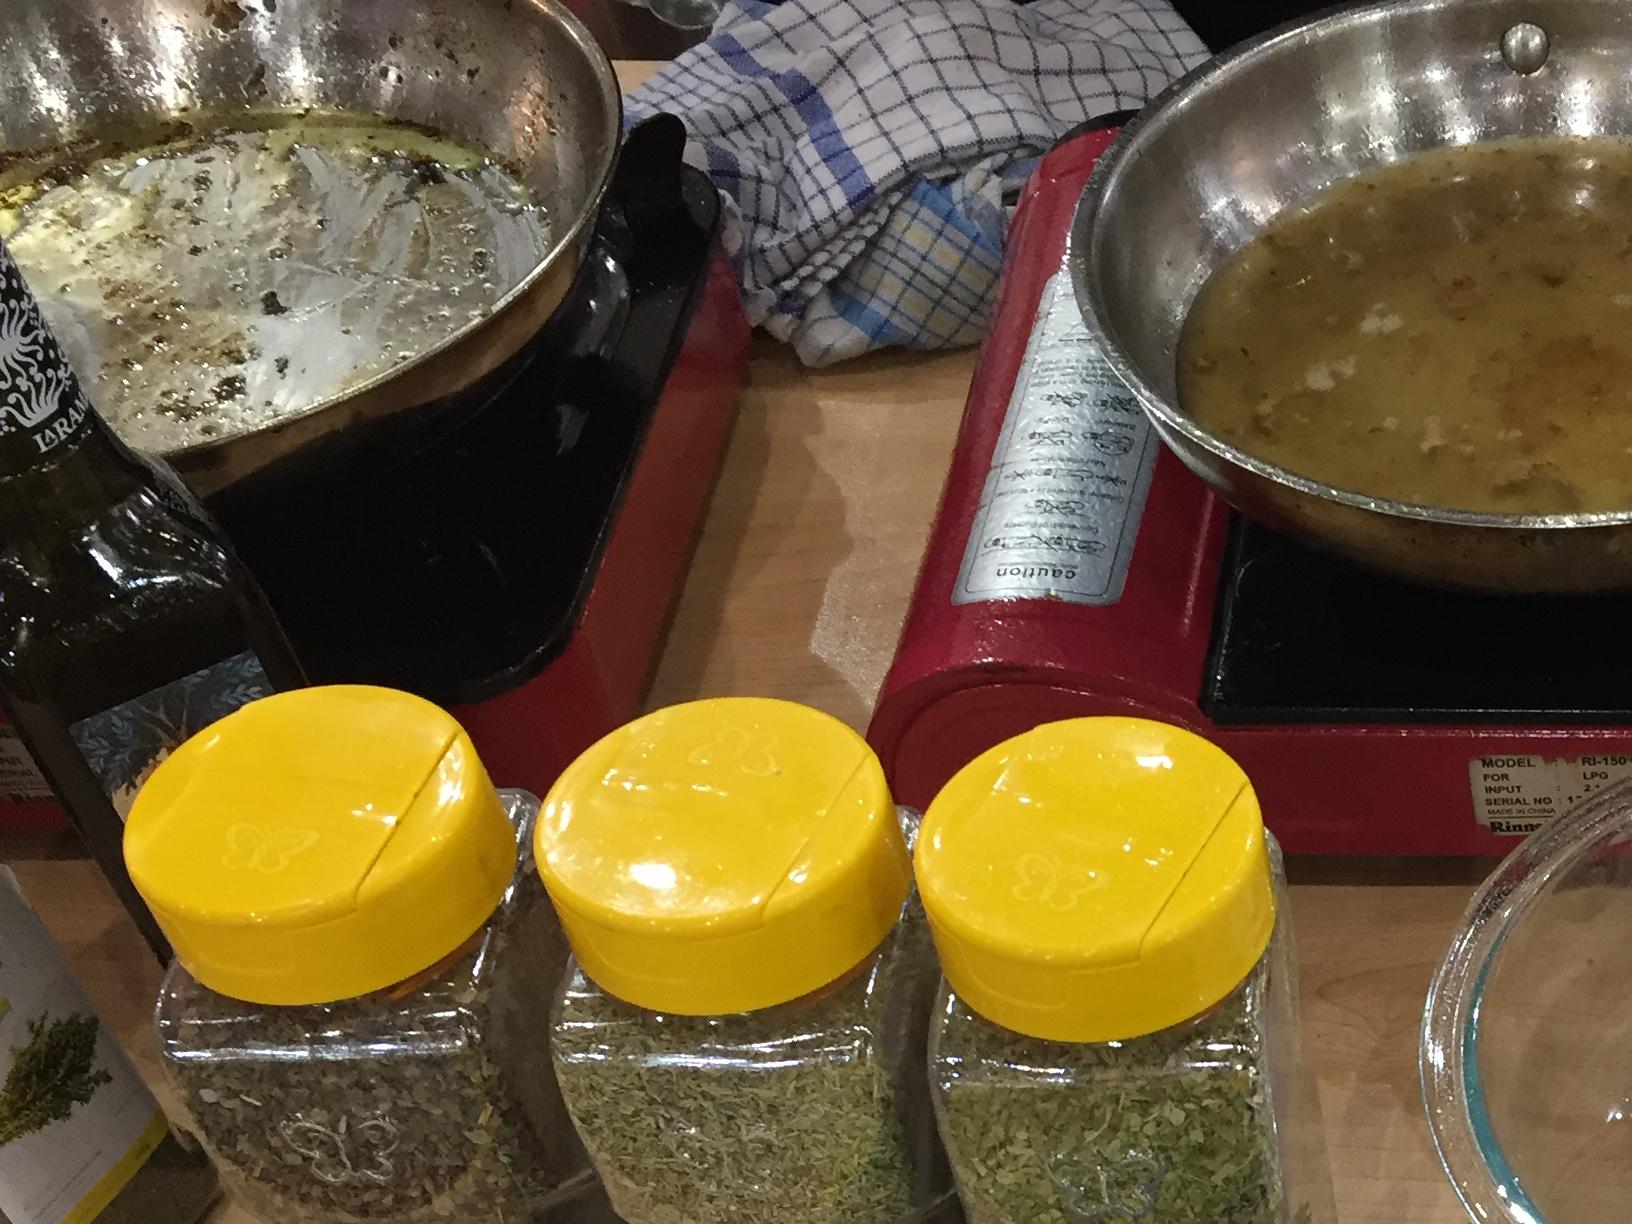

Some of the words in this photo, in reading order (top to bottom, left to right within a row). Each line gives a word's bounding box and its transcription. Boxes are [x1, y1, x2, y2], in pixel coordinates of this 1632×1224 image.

[996, 566, 1077, 580] caution
[1481, 757, 1536, 768] MODEL
[1582, 756, 1626, 766] RI-150
[1483, 773, 1510, 782] FOR
[1583, 771, 1609, 780] LPG
[1485, 785, 1522, 794] INPUT
[1485, 797, 1530, 806] SERIAL
[1534, 796, 1553, 805] NO
